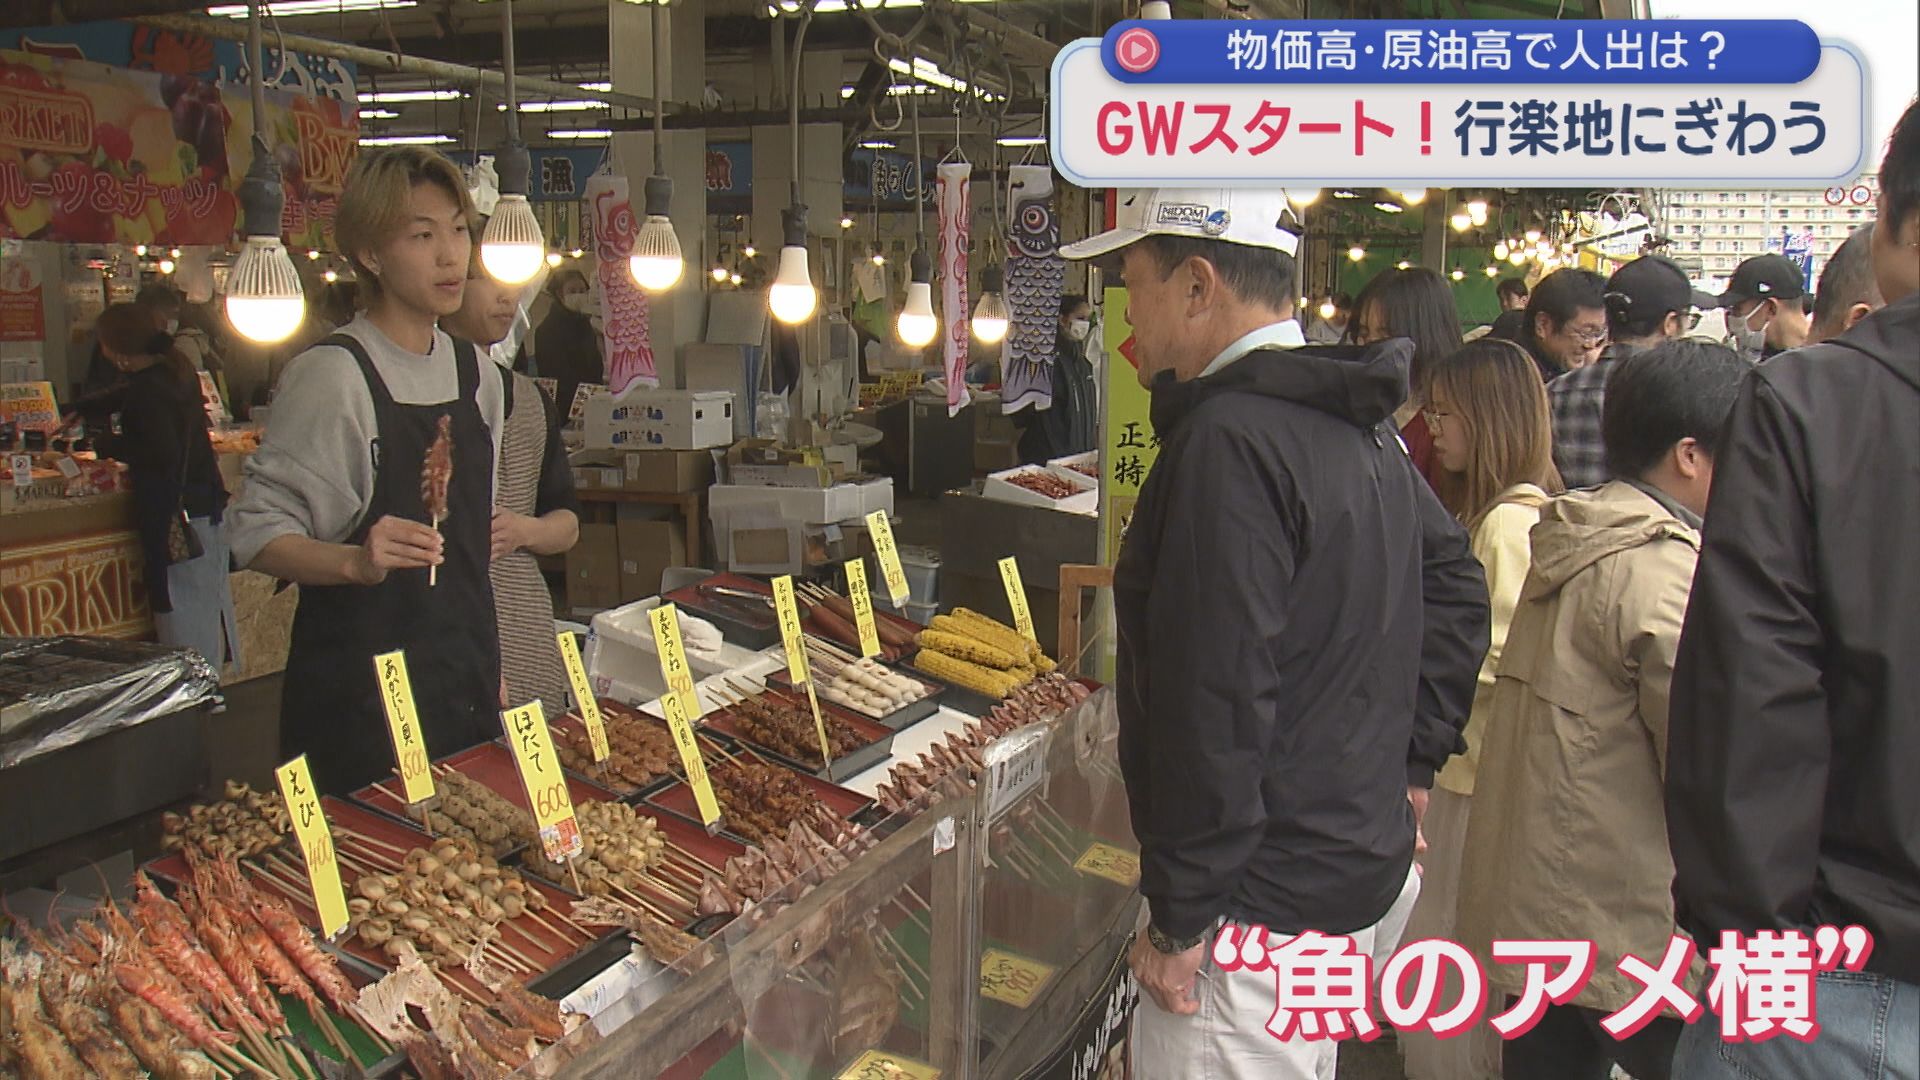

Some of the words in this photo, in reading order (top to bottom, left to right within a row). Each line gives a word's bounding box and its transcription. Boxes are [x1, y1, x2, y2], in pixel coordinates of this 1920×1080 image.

[1161, 205, 1204, 218] NIDOM
[513, 711, 544, 774] ほたて
[403, 749, 427, 781] 500
[289, 769, 315, 829] えび
[536, 782, 571, 818] 600
[308, 834, 332, 875] 400
